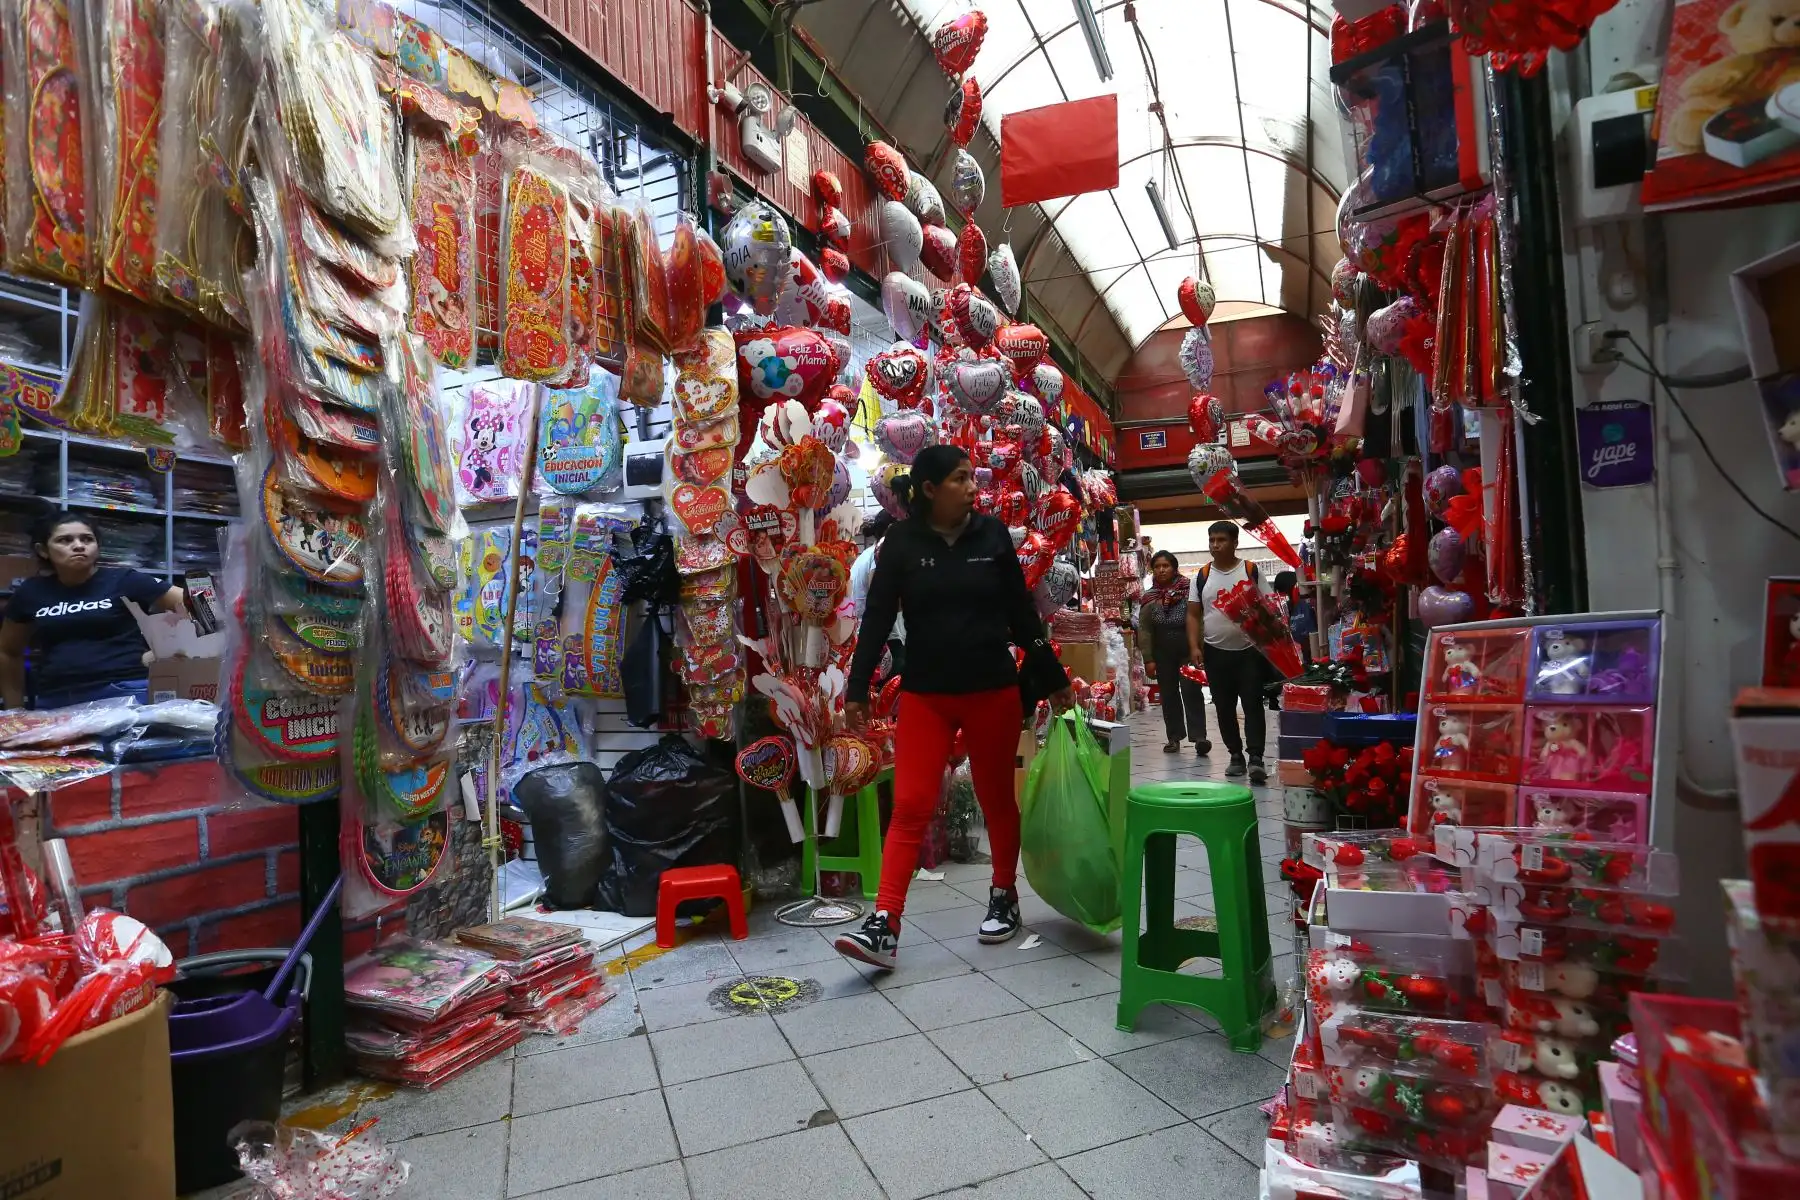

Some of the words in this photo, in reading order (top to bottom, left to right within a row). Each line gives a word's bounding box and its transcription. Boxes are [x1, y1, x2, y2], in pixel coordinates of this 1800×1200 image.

[788, 345, 811, 354] Feliz
[999, 337, 1041, 351] Quiero
[797, 353, 827, 366] Mamá
[1588, 442, 1636, 478] yape
[554, 473, 591, 483] INICIAL
[744, 514, 762, 525] UNA
[36, 598, 113, 618] adidas
